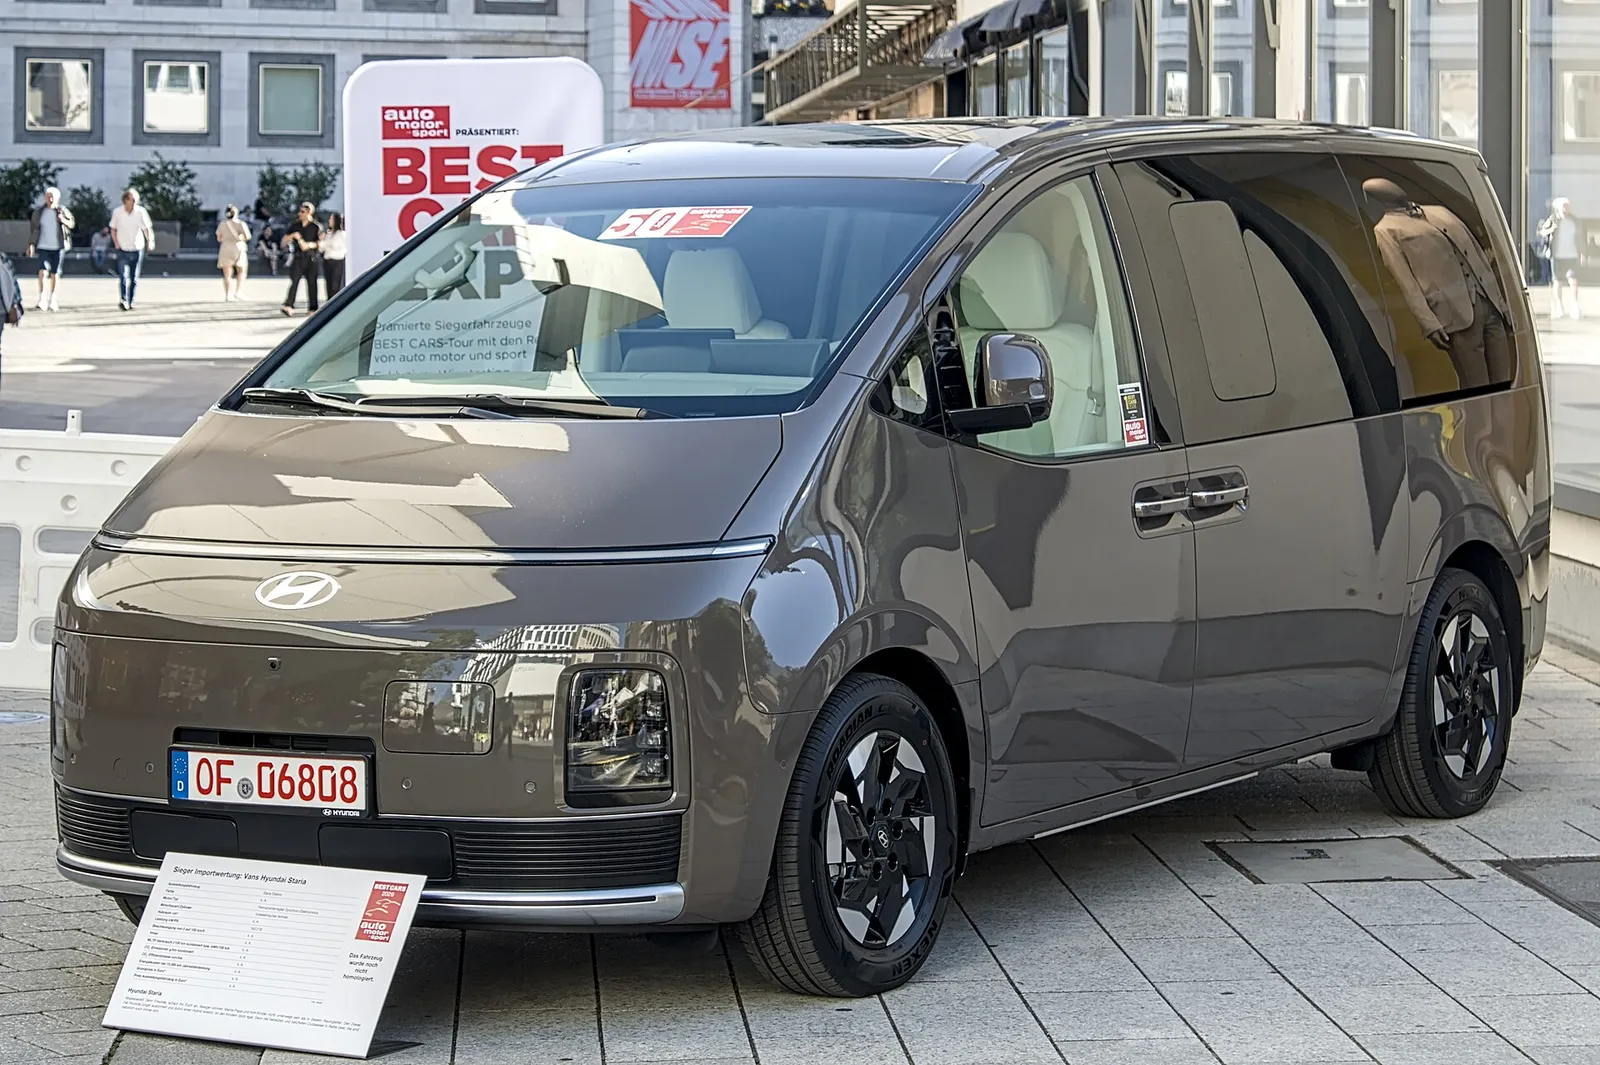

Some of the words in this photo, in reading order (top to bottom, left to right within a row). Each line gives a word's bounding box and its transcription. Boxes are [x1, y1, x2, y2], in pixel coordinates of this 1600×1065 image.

[383, 108, 435, 121] auto
[394, 120, 444, 130] motor
[455, 126, 519, 136] PRÄSENTIERT:
[411, 128, 448, 138] sport
[382, 144, 564, 195] BEST
[435, 319, 532, 332] Siegerfahrzeuge
[374, 339, 405, 350] BEST
[408, 337, 473, 349] CARS-Tour
[477, 336, 497, 347] mit
[499, 335, 523, 347] den
[374, 354, 396, 363] von
[399, 353, 425, 363] auto
[429, 352, 466, 362] motor
[469, 351, 492, 361] und
[495, 350, 527, 362] sport
[827, 704, 873, 780] ROADIAN
[177, 780, 184, 792] D
[196, 757, 235, 796] OF
[257, 761, 358, 804] 06808
[173, 866, 194, 876] Sieger
[194, 868, 243, 880] Importwertung:
[244, 872, 260, 881] Vans
[260, 874, 288, 884] Hyundai
[287, 876, 307, 885] Staria
[360, 921, 387, 931] auto
[891, 919, 938, 977] NEXEN
[360, 953, 383, 962] Fahrzeug
[127, 987, 148, 996] Hyundai
[148, 989, 163, 997] Staria
